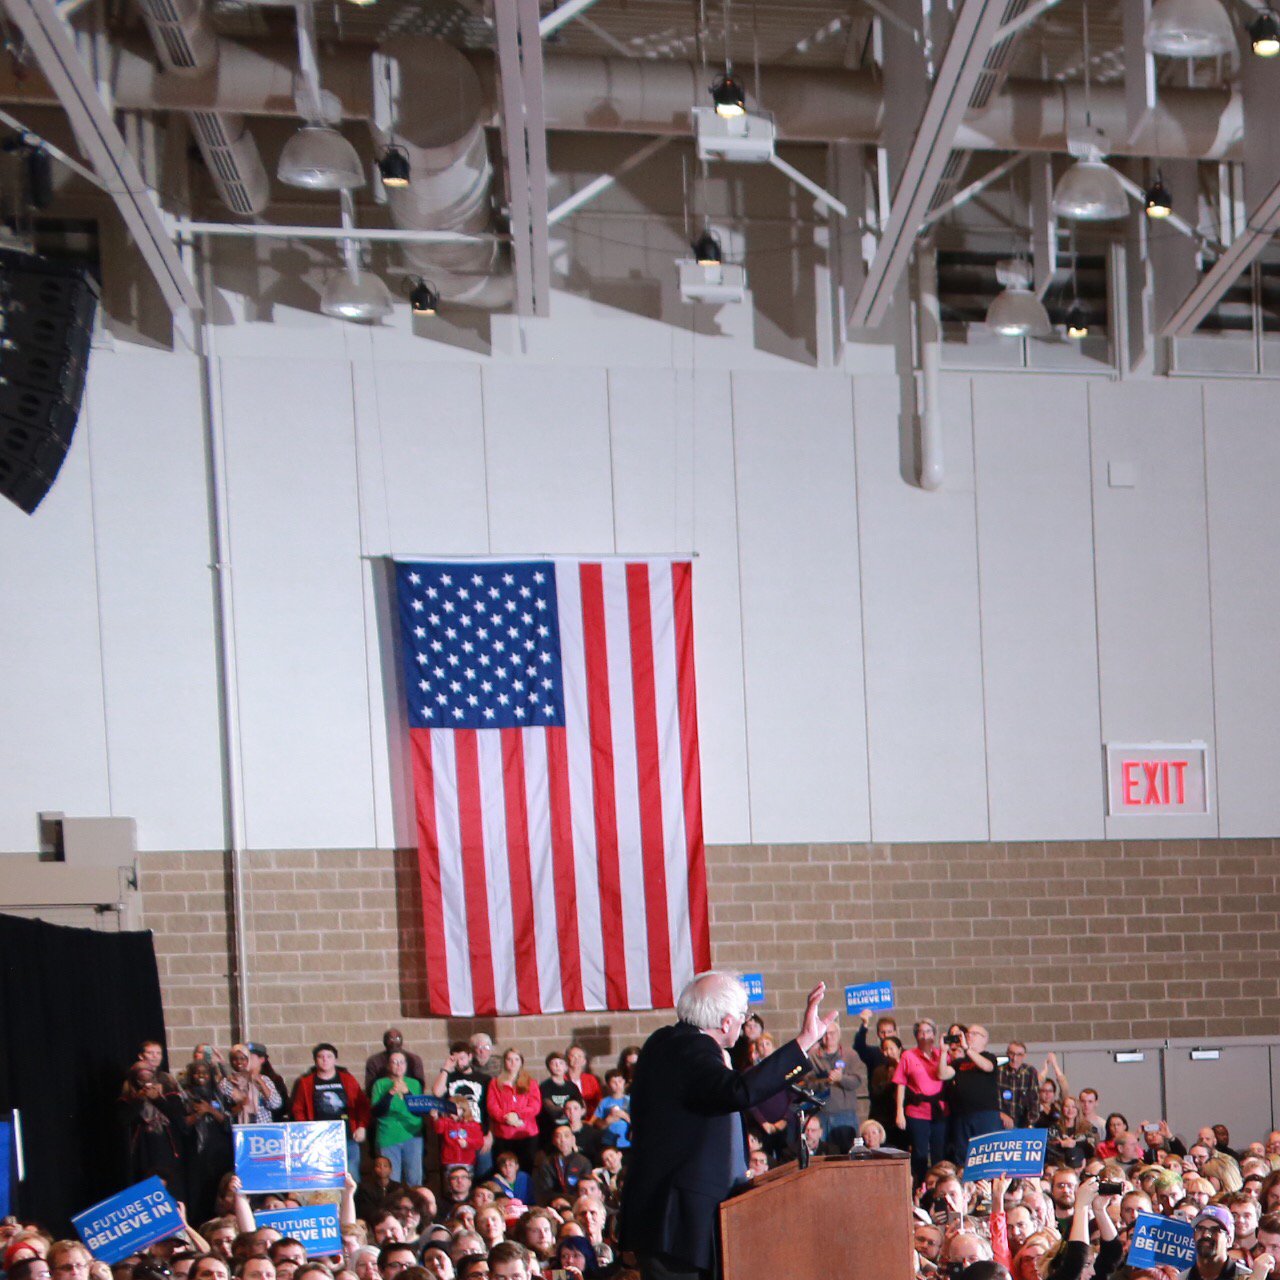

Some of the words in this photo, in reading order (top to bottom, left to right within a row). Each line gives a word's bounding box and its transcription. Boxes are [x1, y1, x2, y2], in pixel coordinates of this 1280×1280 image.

[1122, 761, 1188, 805] EXIT
[847, 996, 878, 1005] BELIEVE
[881, 994, 890, 1002] IN
[853, 989, 878, 997] FUTURE
[970, 1147, 976, 1156] A
[979, 1141, 1022, 1154] FUTURE
[1025, 1140, 1043, 1150] TO
[967, 1151, 1022, 1167] BELIEVE
[1025, 1151, 1042, 1161] IN
[83, 1226, 93, 1237] A
[92, 1200, 145, 1231] FUTURE
[143, 1190, 165, 1205] TO
[87, 1211, 153, 1250] BELIEVE
[152, 1201, 173, 1218] IN
[271, 1217, 317, 1230] FUTURE
[319, 1216, 336, 1226] TO
[322, 1227, 337, 1238] IN
[1138, 1225, 1146, 1236] A
[1149, 1227, 1196, 1249] FUTURE
[1134, 1236, 1195, 1261] BELIEVE
